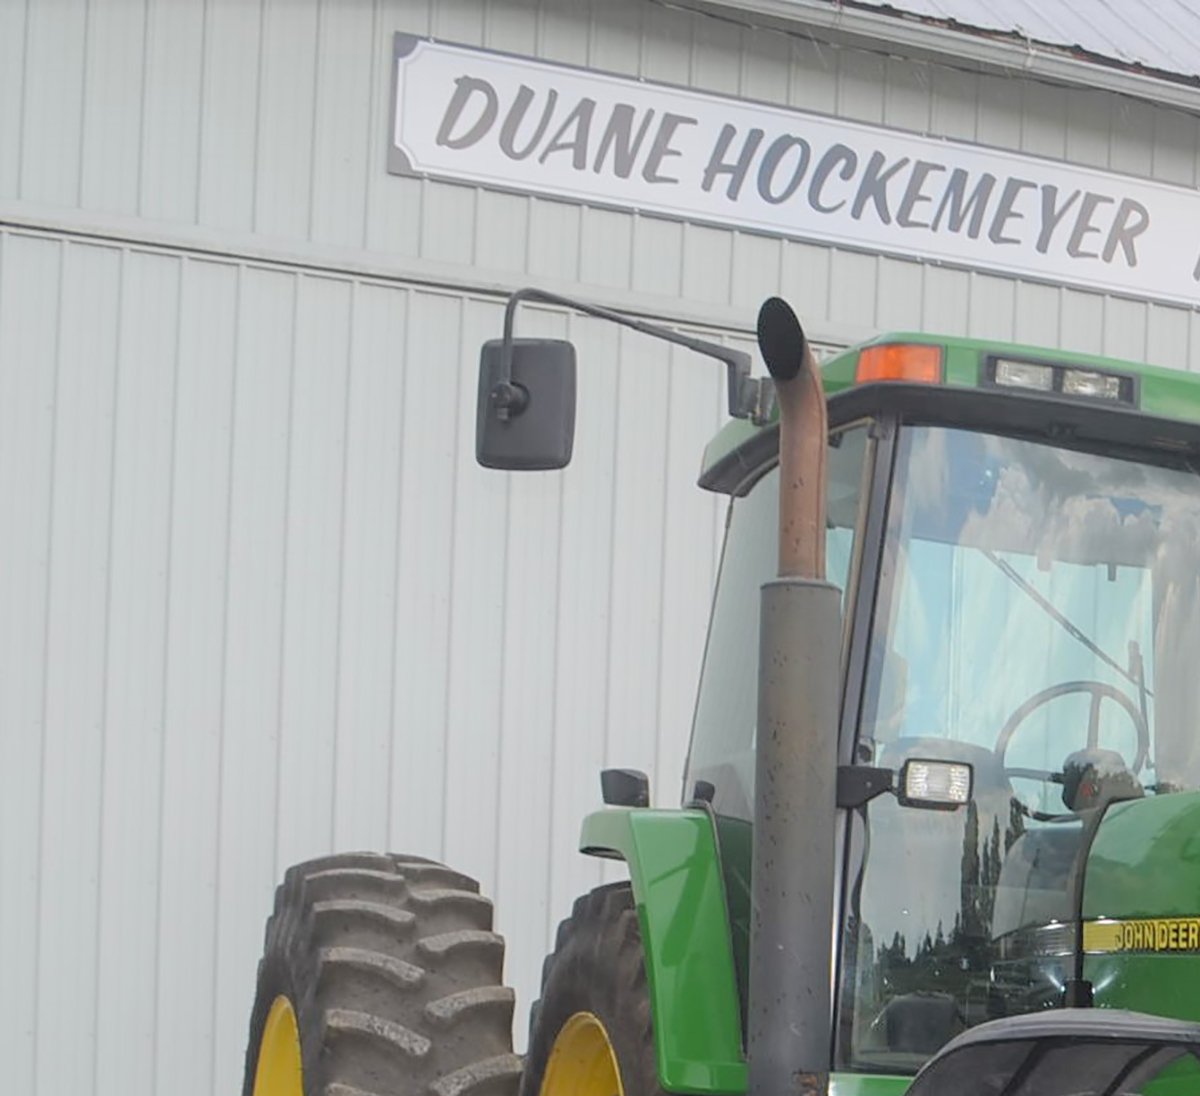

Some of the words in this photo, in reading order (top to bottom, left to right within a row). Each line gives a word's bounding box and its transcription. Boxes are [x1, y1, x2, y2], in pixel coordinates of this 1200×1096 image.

[436, 75, 698, 184] DUANE
[701, 123, 1150, 267] HOCKEMEYER
[1115, 922, 1156, 950] JOHN
